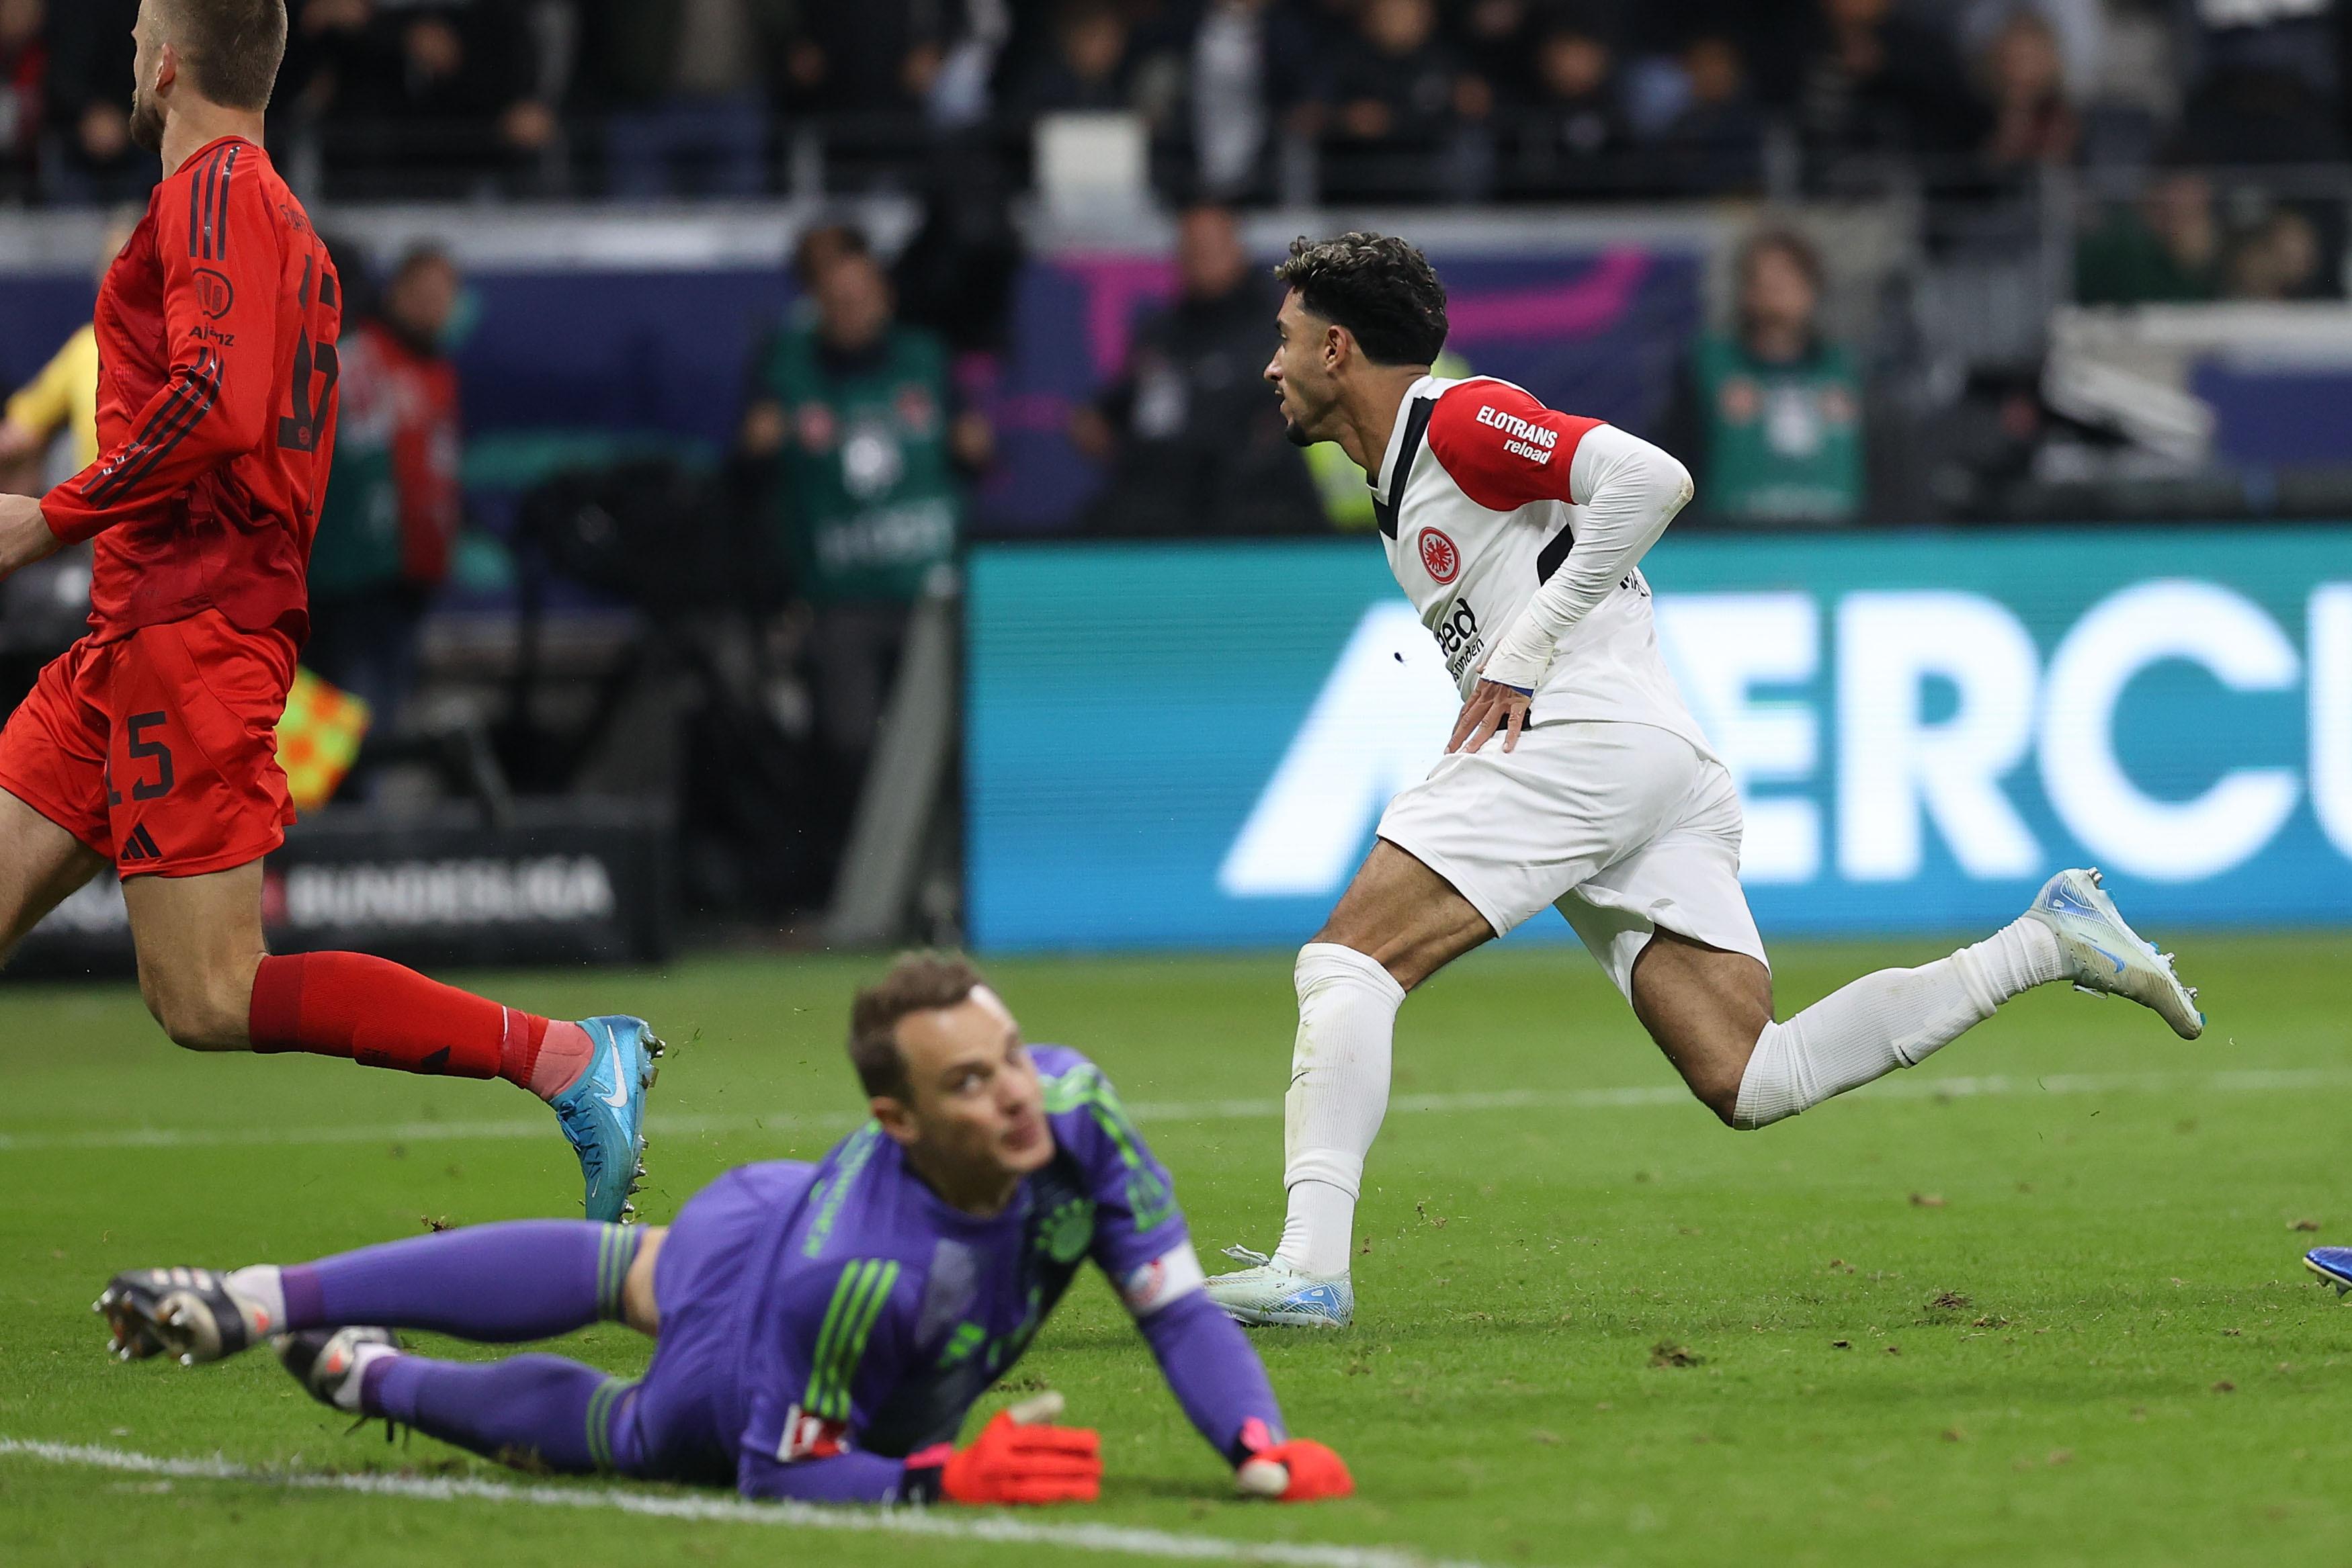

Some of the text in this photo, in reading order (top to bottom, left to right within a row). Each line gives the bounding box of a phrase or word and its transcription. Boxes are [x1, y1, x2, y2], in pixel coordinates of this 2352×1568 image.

[1476, 405, 1558, 449] ELOTRANS
[1503, 439, 1552, 465] reload
[1219, 576, 2352, 896] ERC
